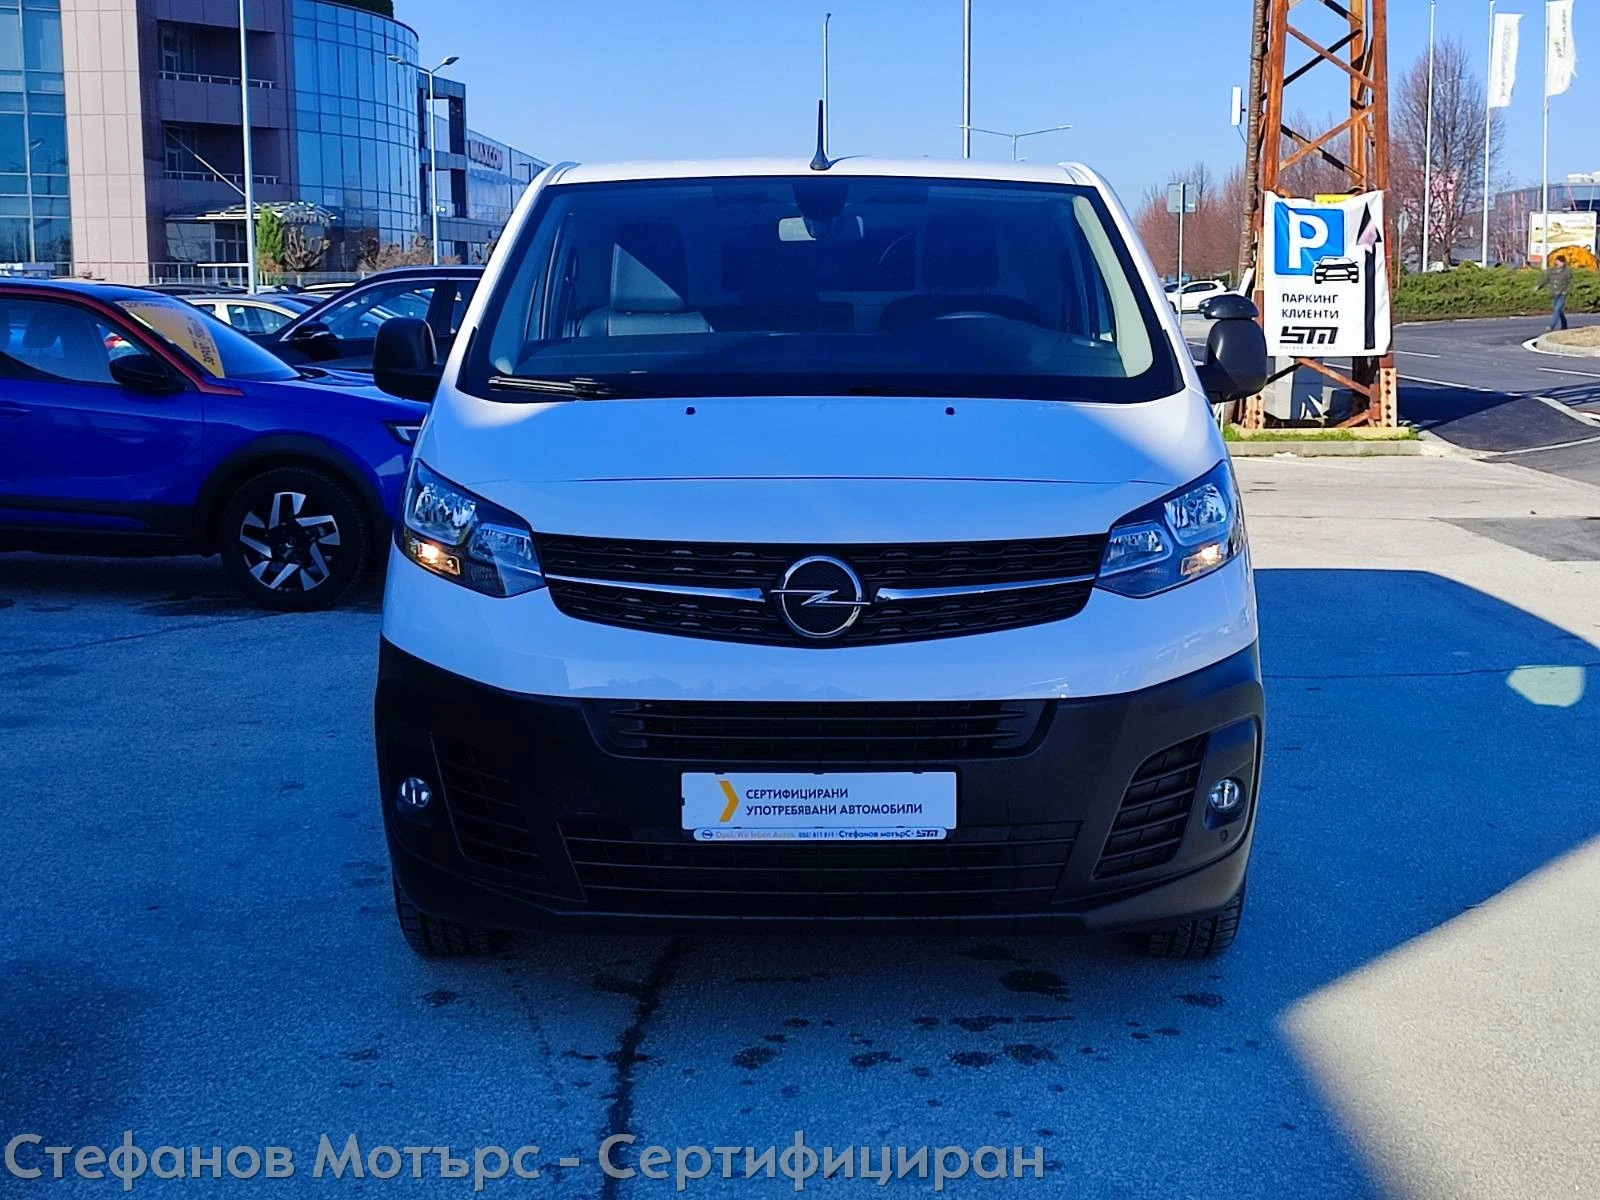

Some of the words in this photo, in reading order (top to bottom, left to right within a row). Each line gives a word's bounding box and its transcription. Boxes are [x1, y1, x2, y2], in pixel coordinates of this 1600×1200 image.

[1288, 210, 1328, 269] P
[1281, 293, 1339, 304] ПАРКИНГ
[1281, 308, 1339, 319] КЛИЕНТИ
[745, 788, 848, 800] СЕРТИФИЦИРАНИ
[746, 804, 837, 816] УПОТРЕБЯВАНИ
[840, 803, 922, 815] АВТОМОБИЛИ
